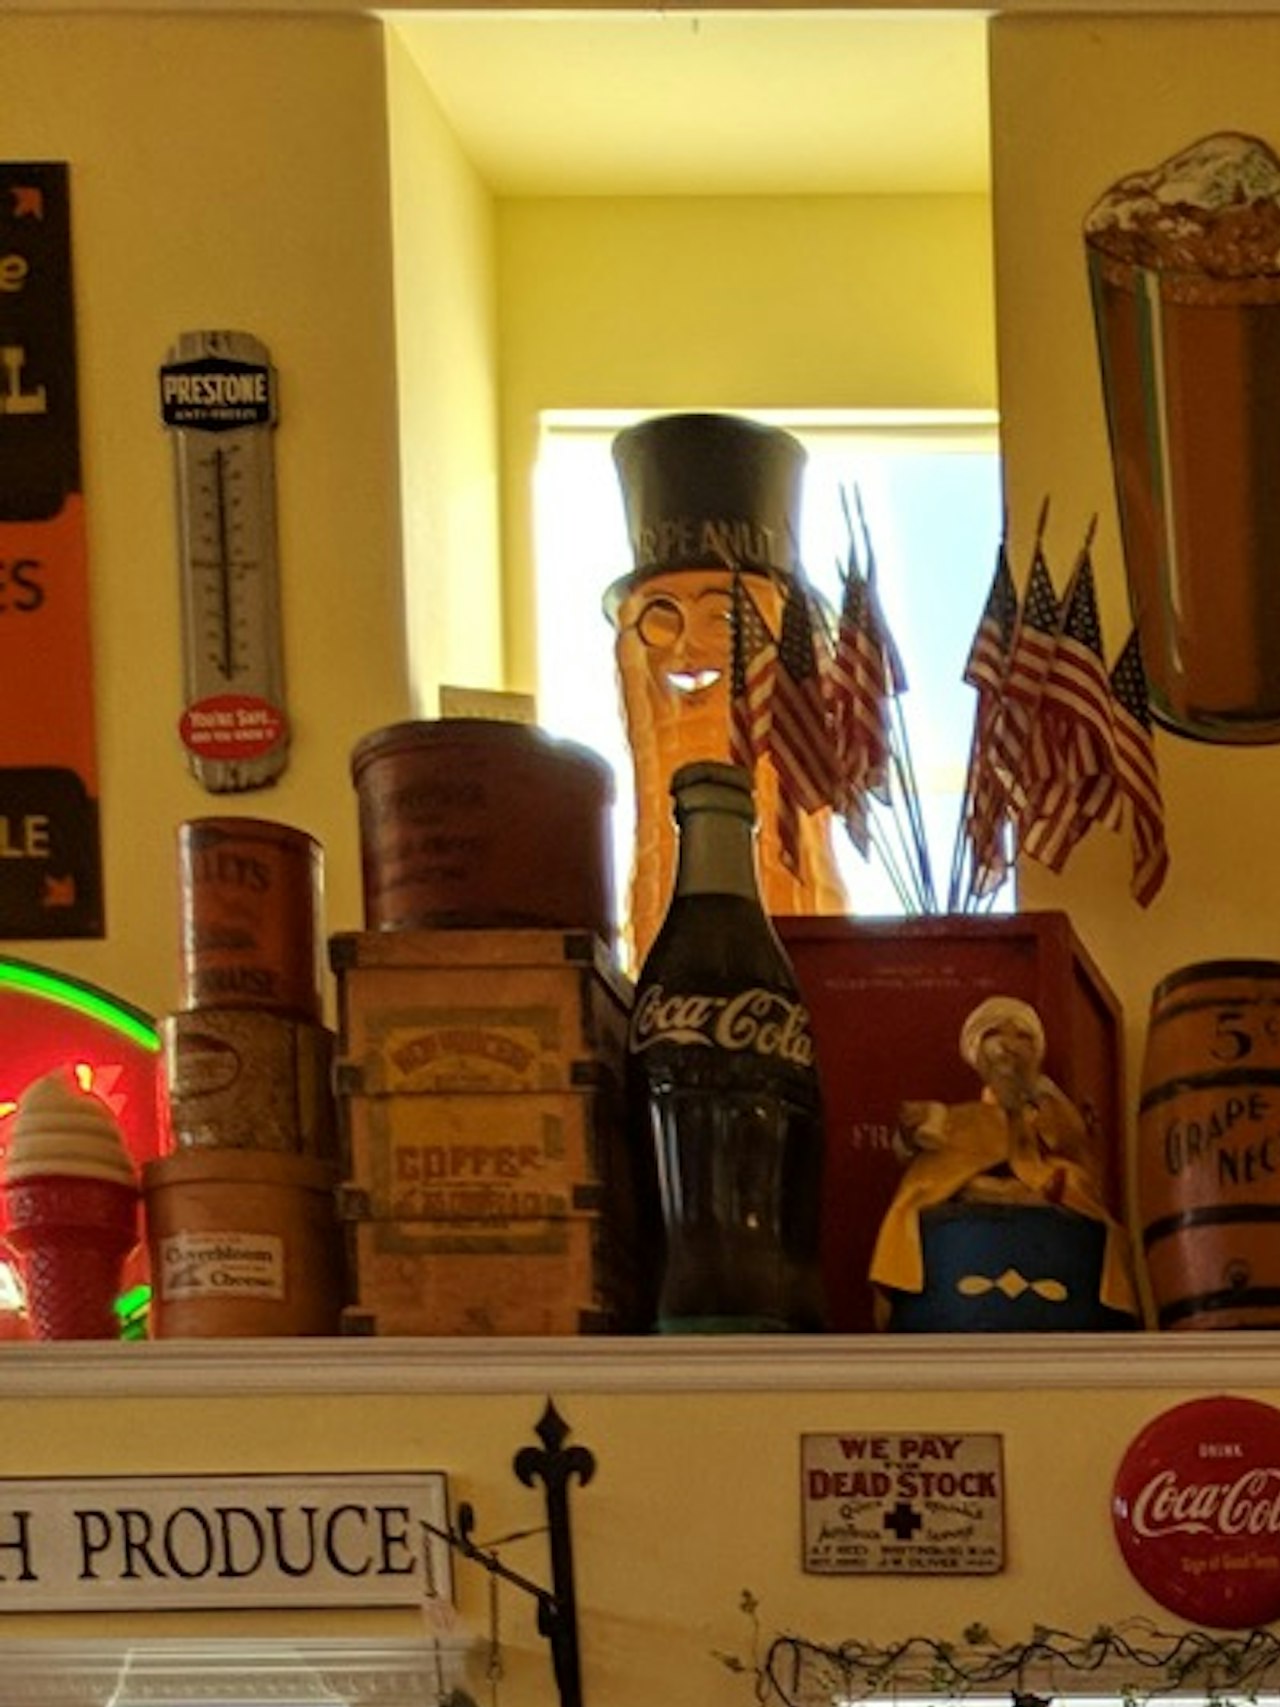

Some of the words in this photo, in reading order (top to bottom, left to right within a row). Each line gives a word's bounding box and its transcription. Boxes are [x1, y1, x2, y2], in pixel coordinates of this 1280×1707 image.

[164, 373, 267, 405] PRESTONE
[629, 986, 814, 1066] Coca-Cola
[1164, 1092, 1271, 1177] GRAPE
[838, 1439, 890, 1460] WE
[899, 1439, 963, 1460] PAY
[1198, 1443, 1244, 1458] DRINK
[808, 1470, 892, 1499] DEAD
[896, 1472, 996, 1499] STOCK
[76, 1504, 415, 1580] PRODUCE
